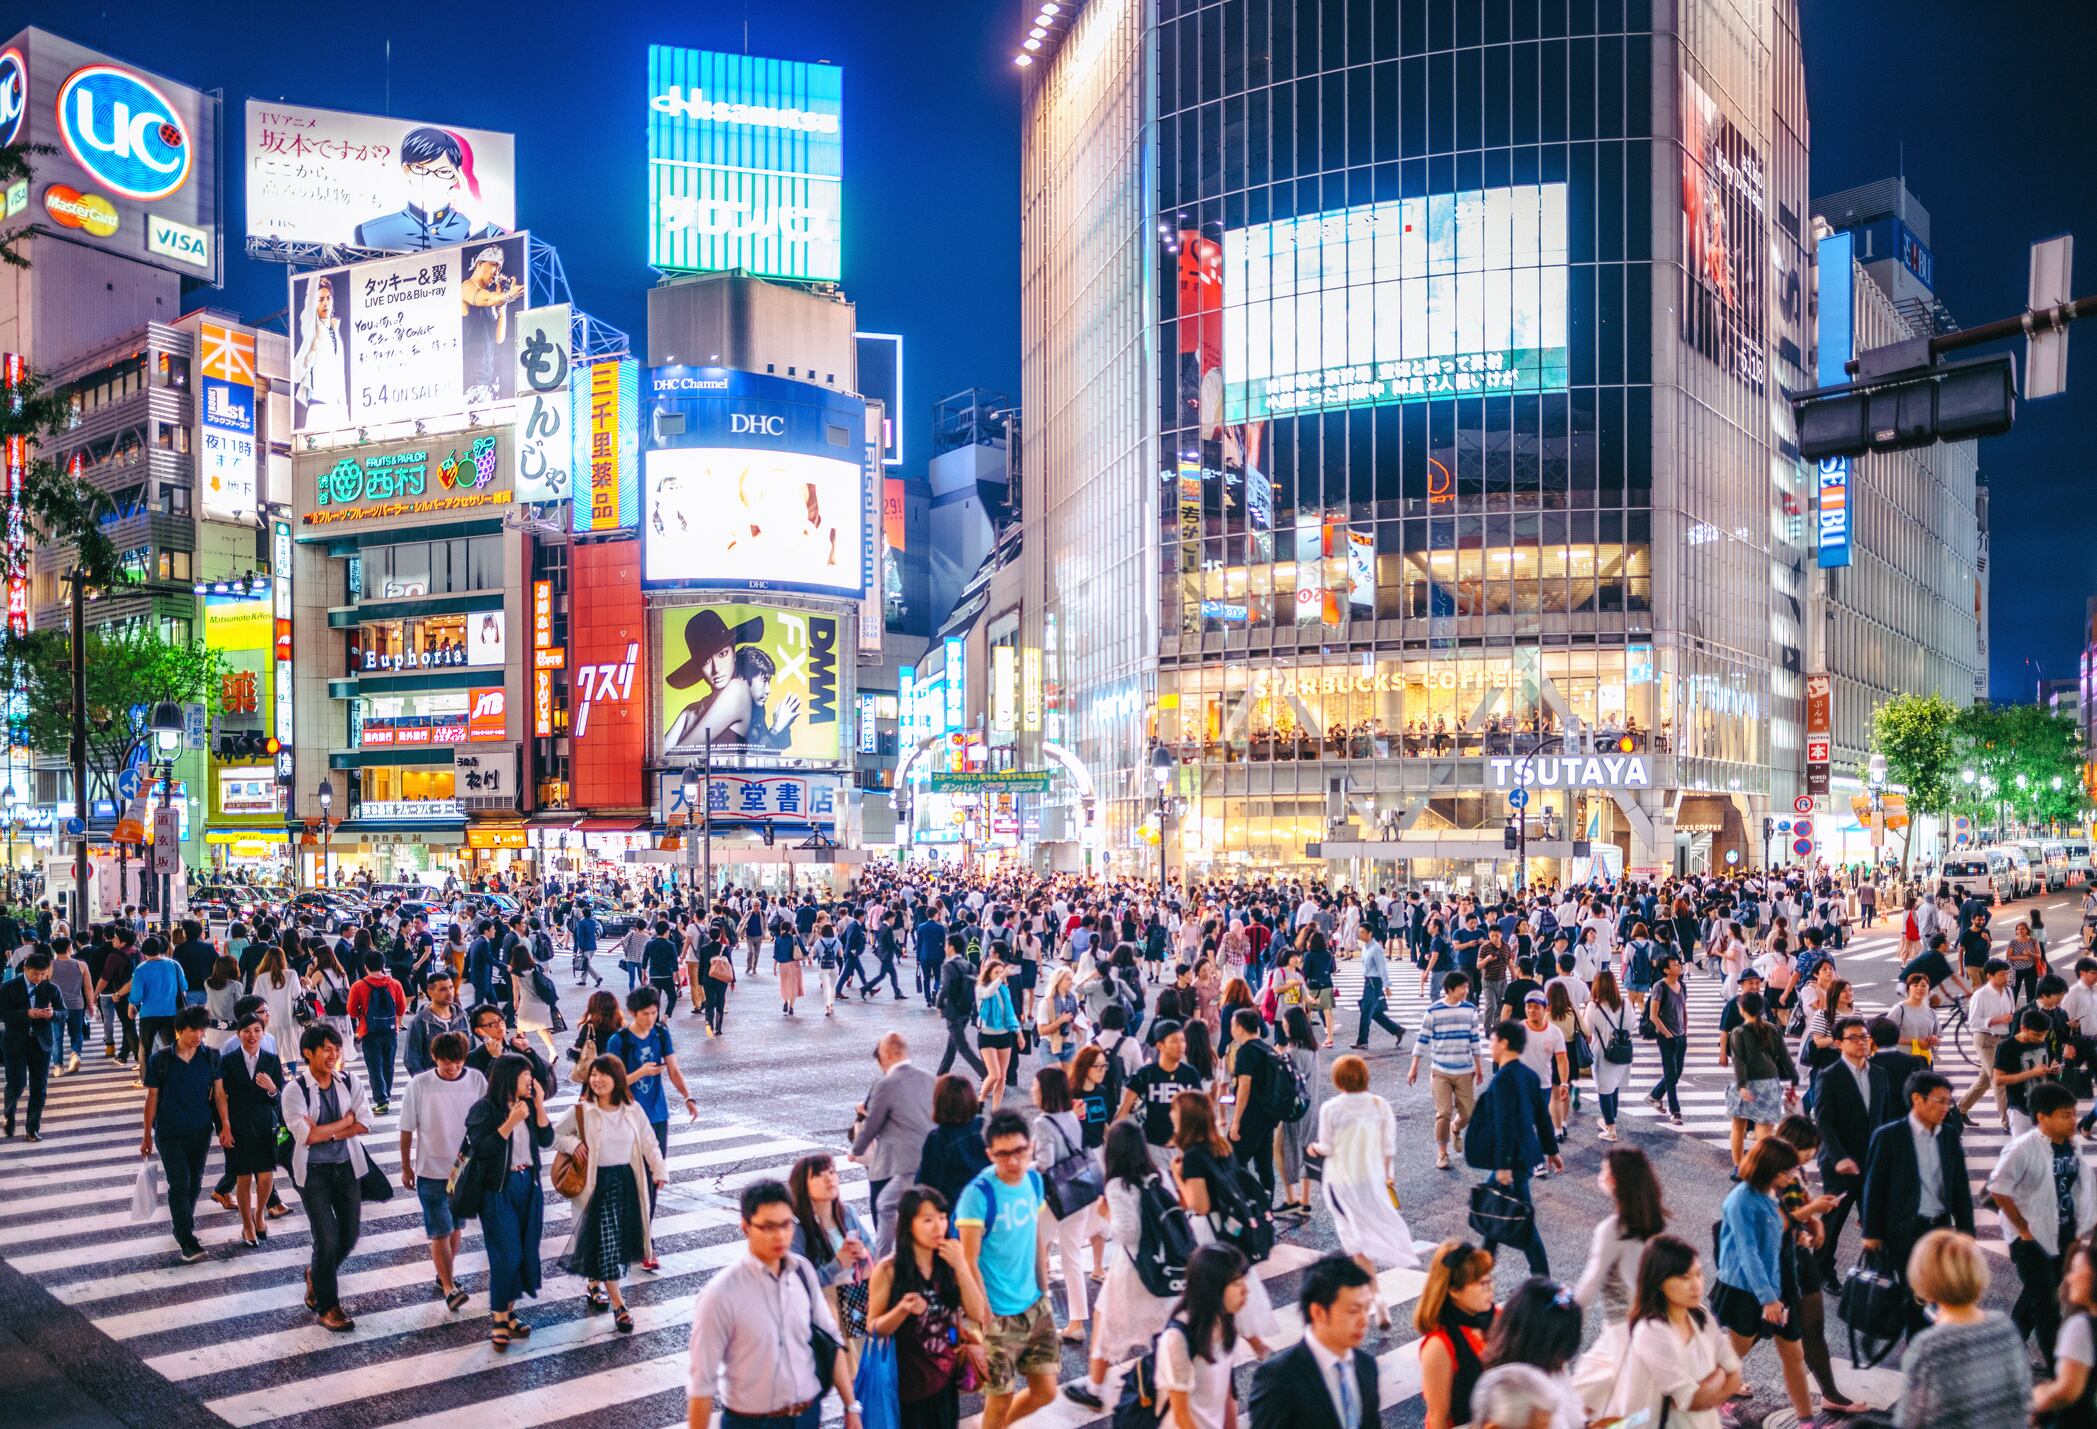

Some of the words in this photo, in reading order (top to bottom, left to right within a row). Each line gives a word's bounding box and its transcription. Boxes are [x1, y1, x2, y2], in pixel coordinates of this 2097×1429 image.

[259, 112, 317, 129] TVアニメ
[47, 195, 118, 226] MasterCard
[156, 228, 205, 257] VISA
[365, 264, 447, 296] タッキー&翼
[365, 296, 384, 308] LIVE
[387, 286, 447, 304] DVD&Blu-ray
[201, 329, 255, 382] 本
[362, 384, 388, 408] 5.4
[653, 379, 679, 391] DHC
[681, 378, 728, 390] Channel
[520, 328, 568, 494] もんじゃ
[730, 413, 784, 436] DHC
[205, 433, 251, 457] 夜11時
[592, 369, 613, 520] 三千里薬品
[318, 475, 330, 504] 渋谷
[366, 464, 427, 500] 西村
[749, 580, 769, 589] DHC
[209, 615, 250, 624] Matsumoto
[366, 646, 462, 671] Euphoria
[776, 612, 807, 687] FX
[809, 616, 836, 725] DMM
[1253, 671, 1407, 697] STARBUCKS
[1423, 668, 1523, 690] COFFEE
[222, 670, 258, 714] 薬
[575, 642, 639, 737] クスリ
[471, 692, 504, 720] JTB
[193, 706, 203, 747] 渋谷駅前
[1811, 745, 1826, 760] 本
[465, 769, 499, 790] 松川
[1490, 757, 1648, 786] TSUTAYA
[670, 782, 834, 813] 大盛堂書店
[157, 814, 169, 867] 道玄坂
